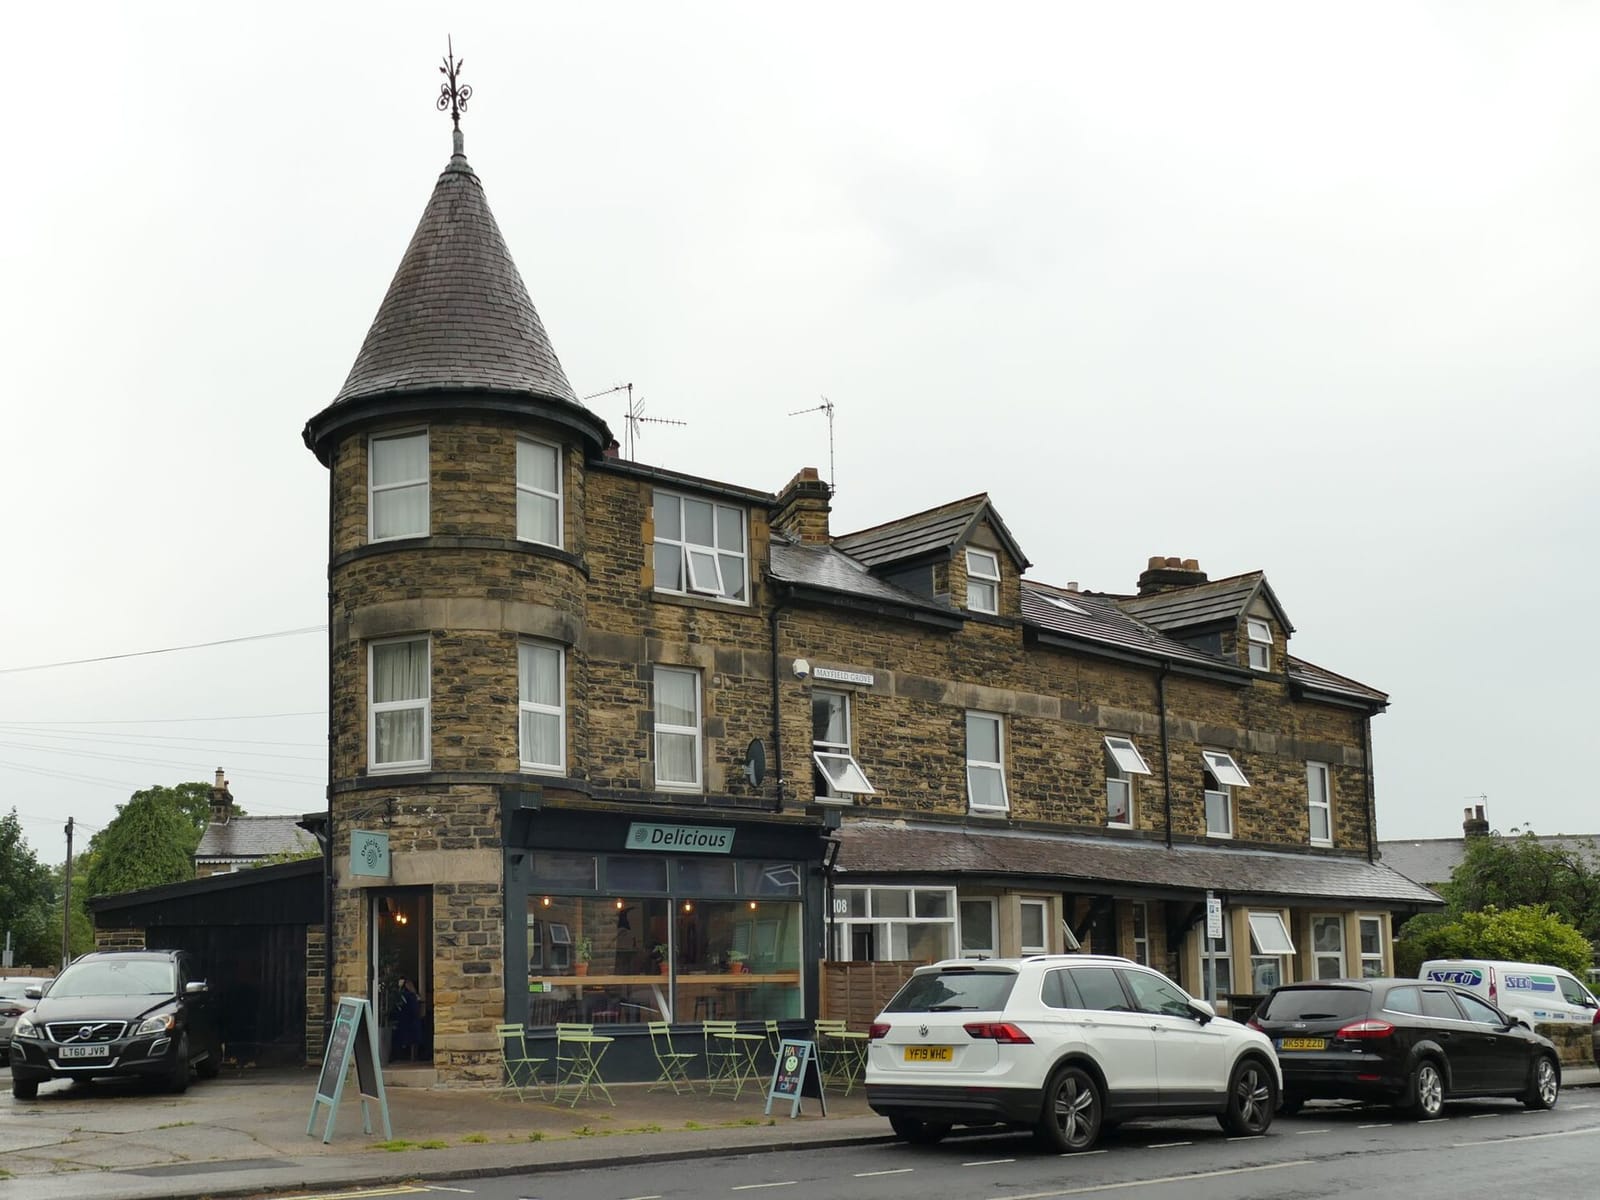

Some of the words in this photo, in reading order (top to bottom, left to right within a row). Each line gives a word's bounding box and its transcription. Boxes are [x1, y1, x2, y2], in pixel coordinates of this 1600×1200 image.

[817, 669, 849, 680] MAYFIELD
[850, 673, 872, 683] GROVE
[651, 828, 726, 847] Delicious
[833, 899, 847, 913] 108
[62, 1048, 86, 1057] LT60
[88, 1047, 105, 1056] JVR
[909, 1048, 928, 1059] YF19
